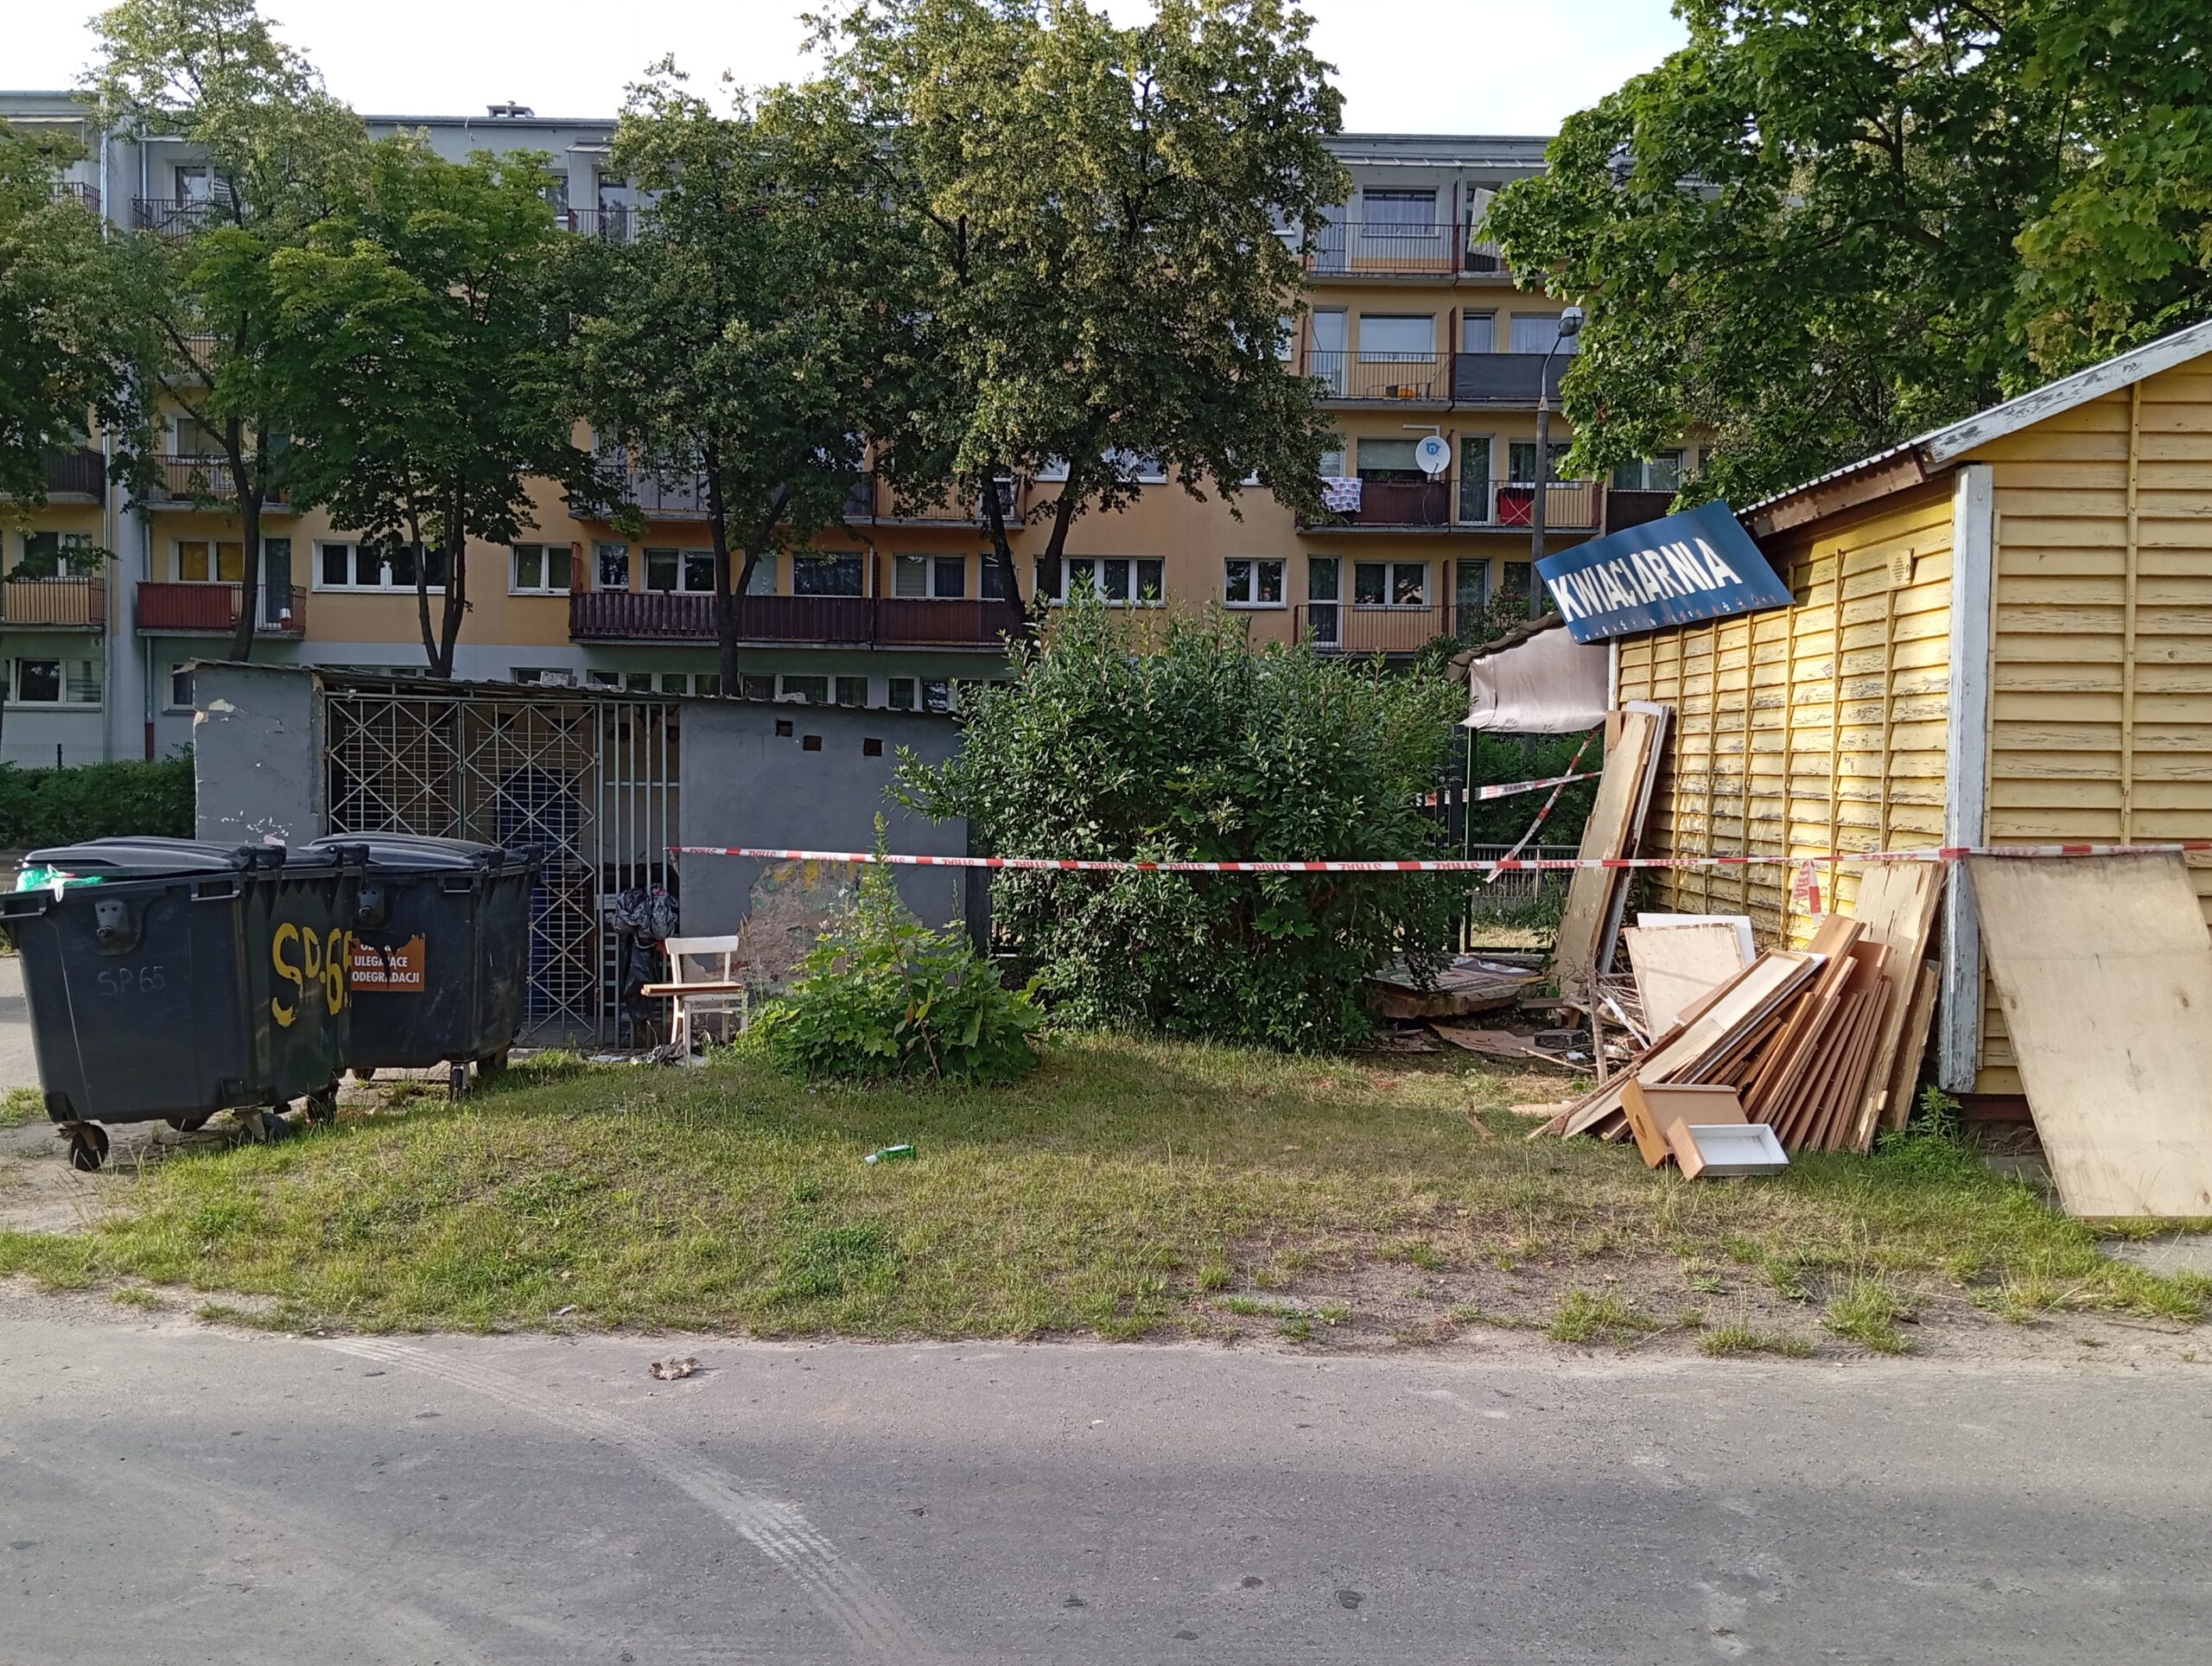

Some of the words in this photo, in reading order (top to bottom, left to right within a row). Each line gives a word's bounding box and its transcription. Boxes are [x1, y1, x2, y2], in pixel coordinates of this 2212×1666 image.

[1548, 537, 1743, 622] KWIACIARNIA
[354, 956, 408, 970] ULEGAĄCE
[139, 966, 164, 993] 65
